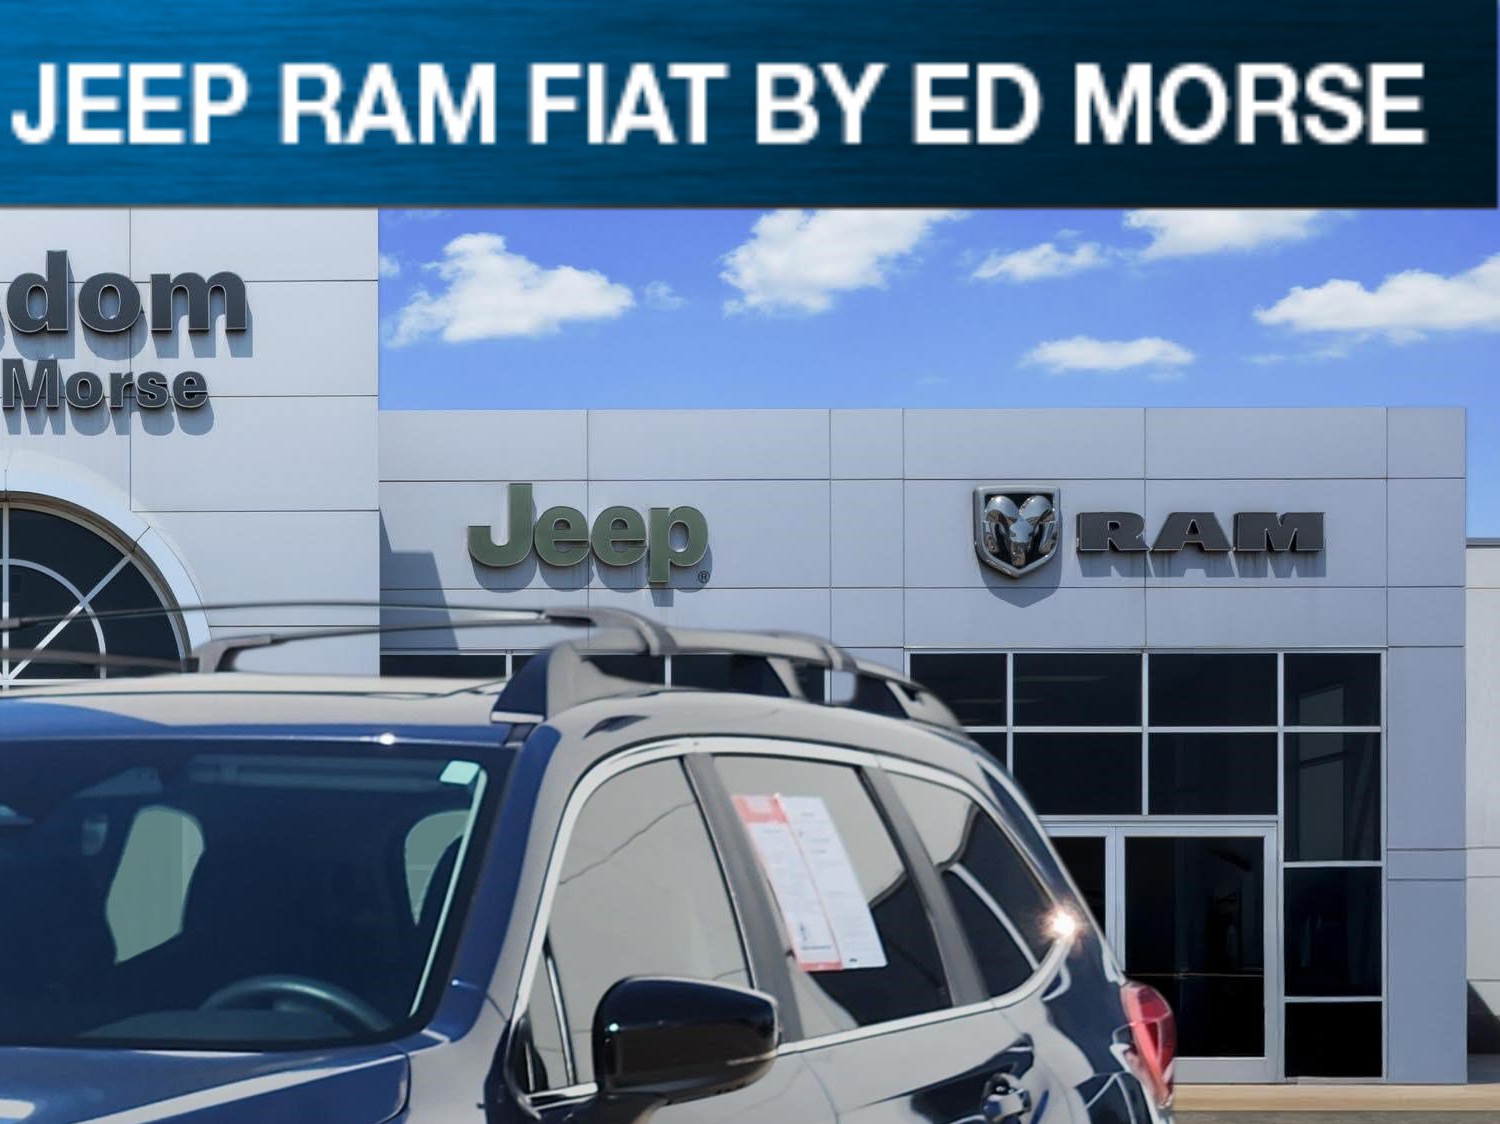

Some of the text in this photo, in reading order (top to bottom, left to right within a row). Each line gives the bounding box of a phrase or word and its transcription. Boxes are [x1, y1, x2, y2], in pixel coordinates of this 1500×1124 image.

[2, 358, 209, 409] Morse
[467, 483, 709, 583] Jeep
[1075, 511, 1327, 553] RAM
